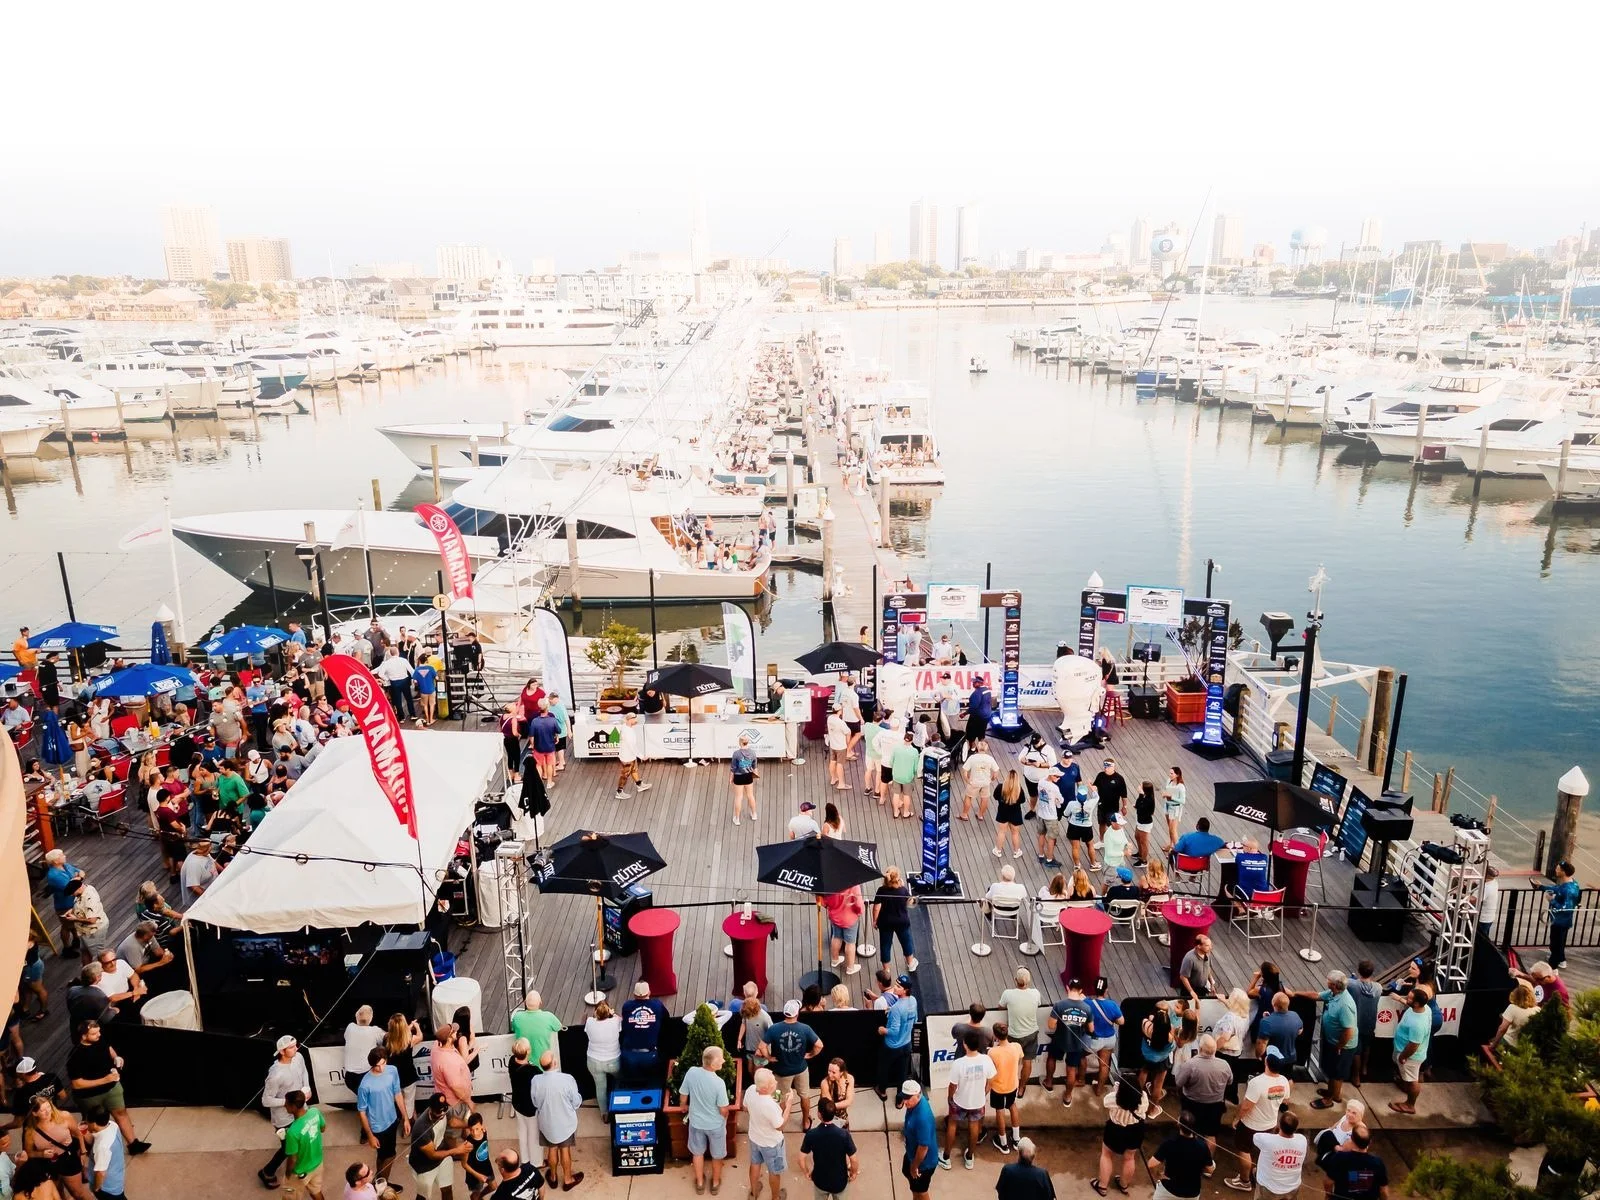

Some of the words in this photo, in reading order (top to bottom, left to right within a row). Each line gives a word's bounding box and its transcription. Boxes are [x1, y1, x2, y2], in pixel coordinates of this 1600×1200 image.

[440, 527, 469, 592] YAMAHA
[438, 597, 446, 608] E
[1141, 598, 1169, 606] QUEST
[1027, 680, 1053, 688] Atla
[1062, 1014, 1087, 1023] COSTA
[1396, 1007, 1457, 1023] YHA
[933, 1048, 956, 1063] Ra
[1278, 1155, 1297, 1164] 401
